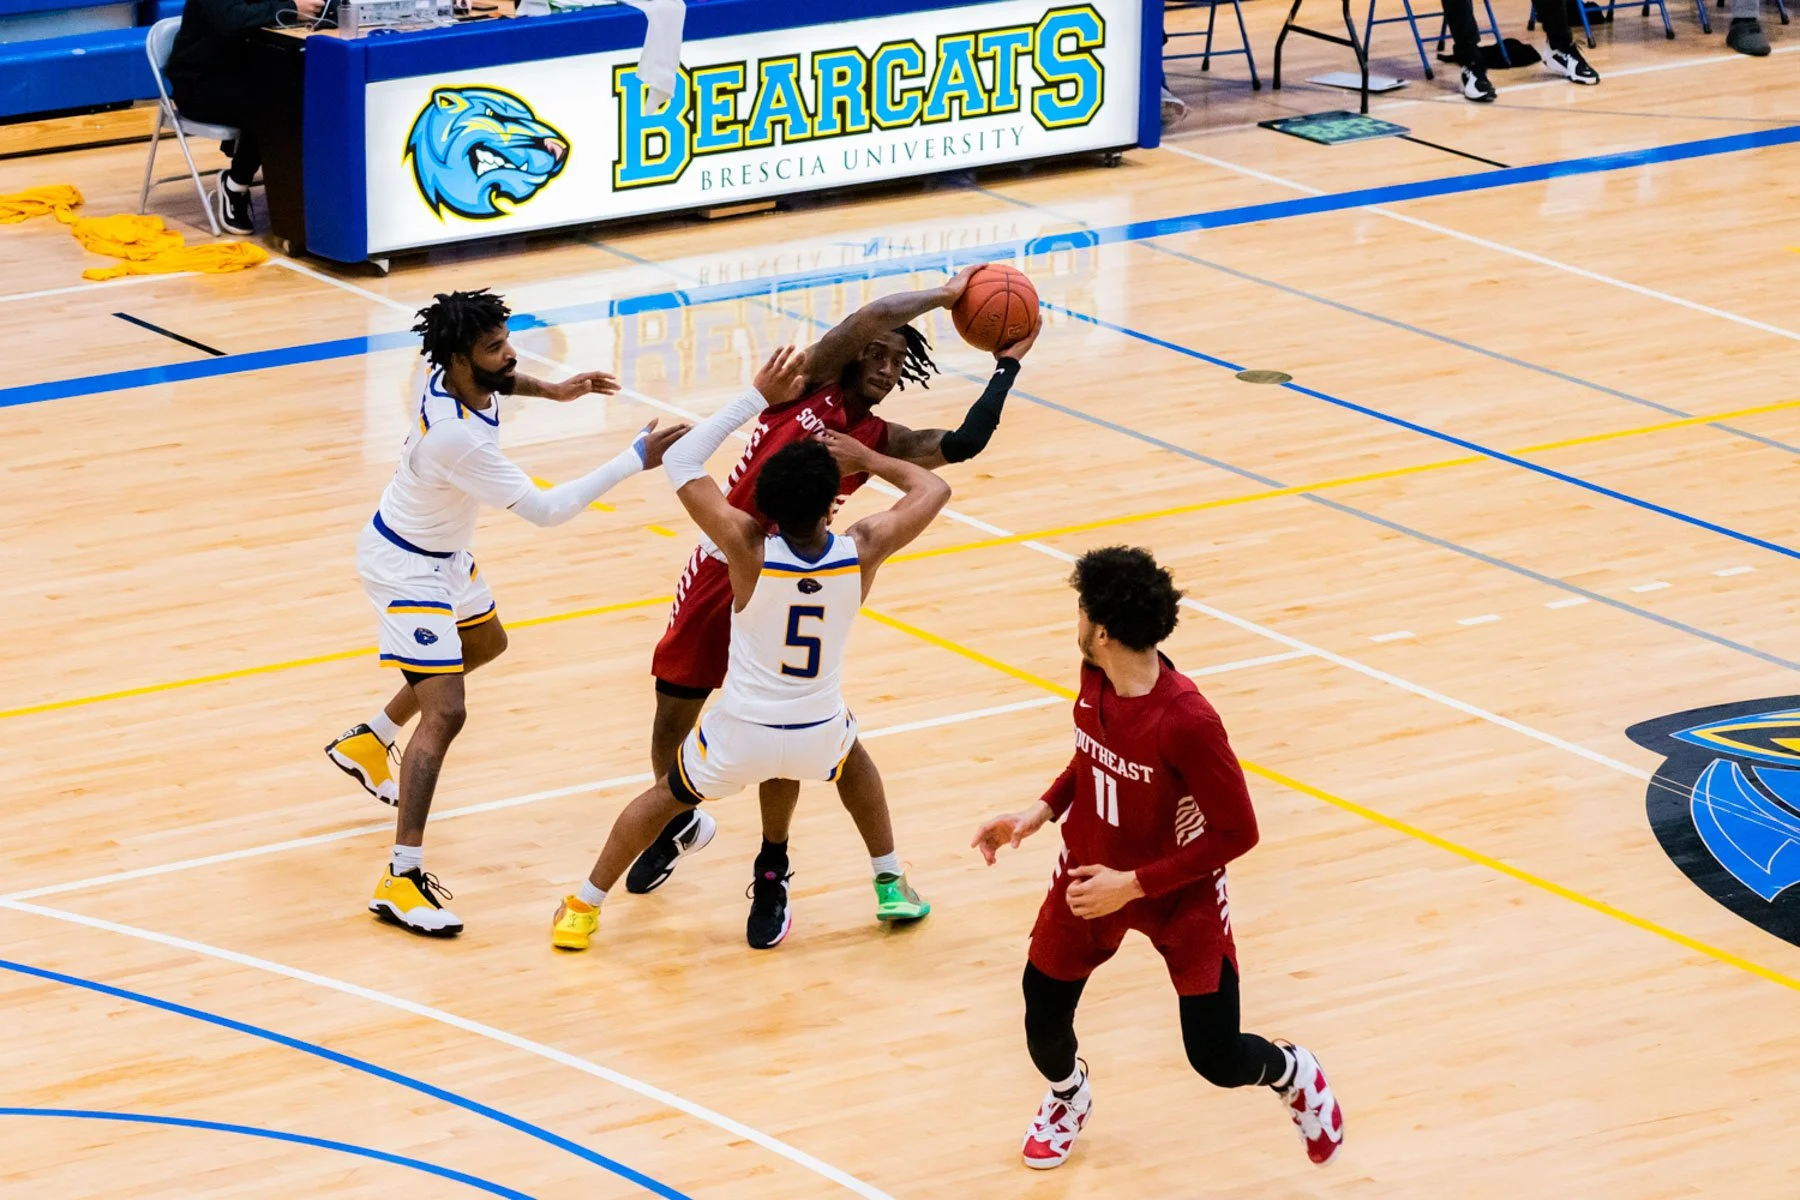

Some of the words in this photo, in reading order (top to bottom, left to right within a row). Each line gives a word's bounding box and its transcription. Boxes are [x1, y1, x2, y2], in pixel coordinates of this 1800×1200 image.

[612, 3, 1105, 192] BEARCATS
[701, 155, 826, 191] BRESCIA
[843, 126, 1025, 171] UNIVERSITY
[780, 604, 825, 679] 5
[1074, 726, 1154, 784] OUTHEAST
[1092, 766, 1120, 827] 11
